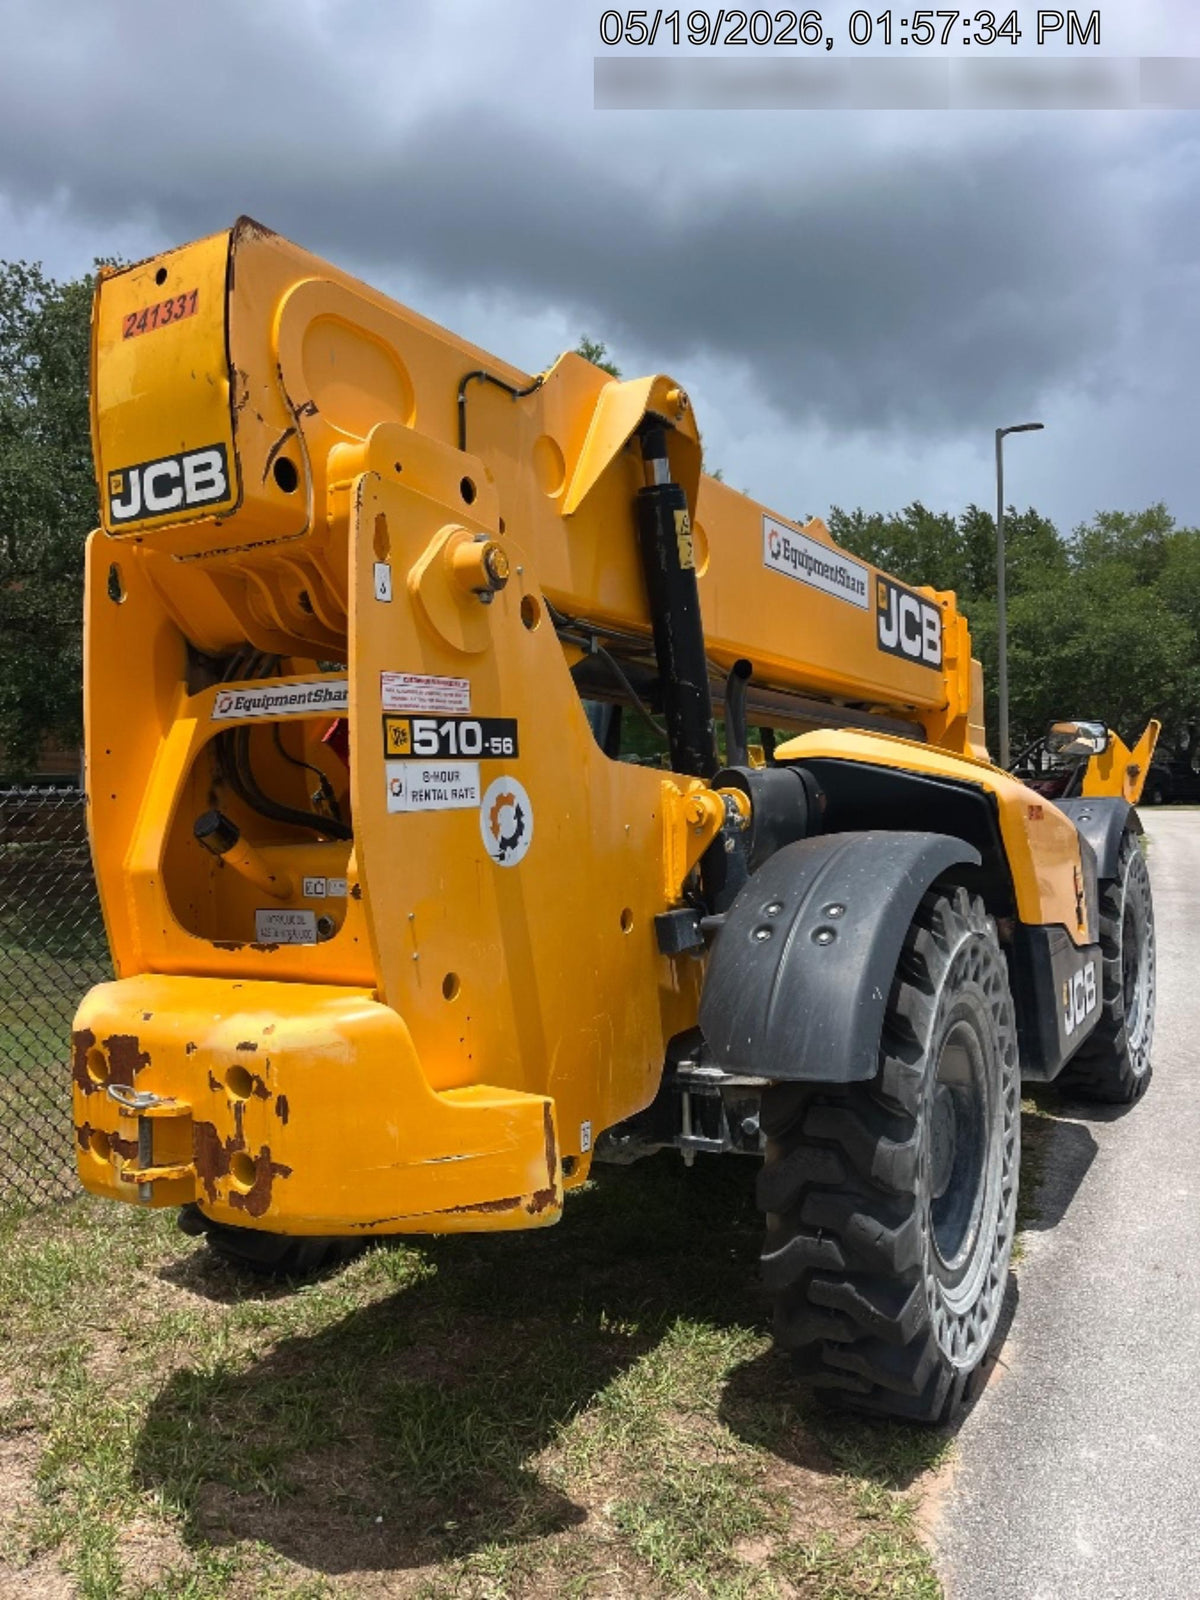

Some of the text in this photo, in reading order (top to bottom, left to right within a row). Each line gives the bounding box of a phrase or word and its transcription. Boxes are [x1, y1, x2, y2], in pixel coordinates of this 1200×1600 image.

[123, 288, 199, 340] 241331
[111, 449, 227, 519] JCB
[781, 537, 866, 597] EquipmentShare
[879, 587, 942, 666] JCB
[234, 688, 348, 711] EquipmentShar
[411, 787, 476, 802] RENTAL RATE
[422, 771, 460, 783] 8-HOUR
[1063, 960, 1097, 1036] JCB
